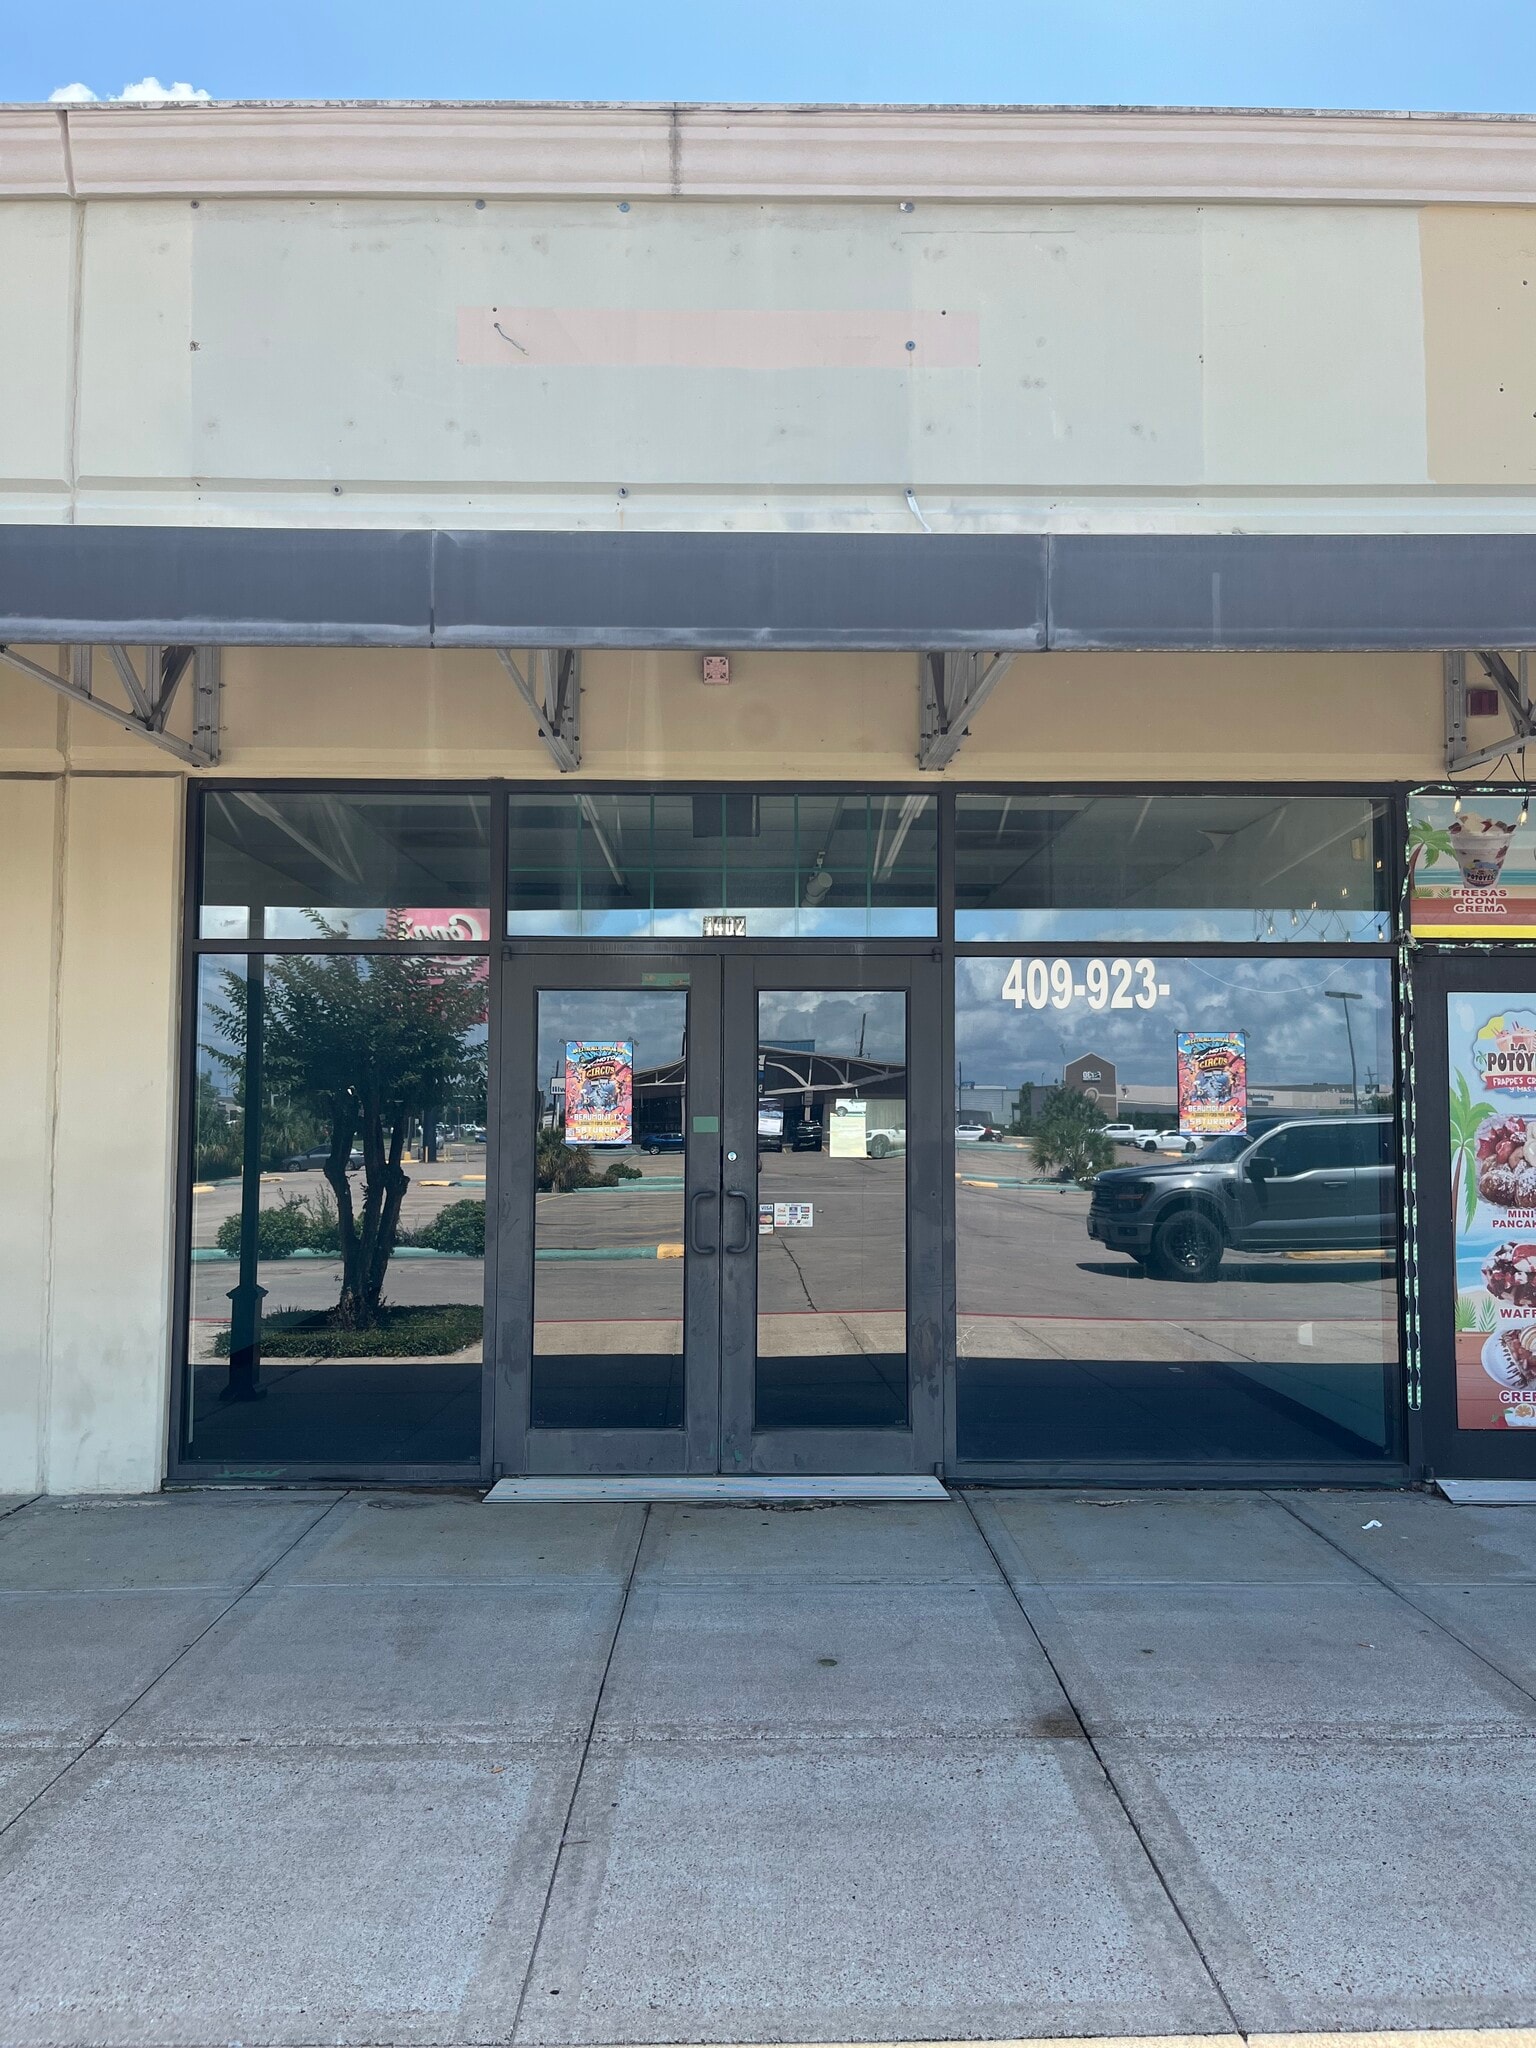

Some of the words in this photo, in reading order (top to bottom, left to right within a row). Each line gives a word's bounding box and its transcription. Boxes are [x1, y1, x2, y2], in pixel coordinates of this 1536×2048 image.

[1452, 889, 1507, 897] FRESAS
[1465, 897, 1494, 905] CON
[1455, 905, 1505, 913] CREMA
[1001, 958, 1170, 1010] 409-923-
[1510, 1043, 1527, 1051] LA
[1199, 1057, 1228, 1069] CIRCUS
[1487, 1052, 1536, 1072] POTOY
[586, 1065, 615, 1077] CIRCUS
[576, 1126, 622, 1134] SATURDAY
[1508, 1210, 1534, 1218] MINI
